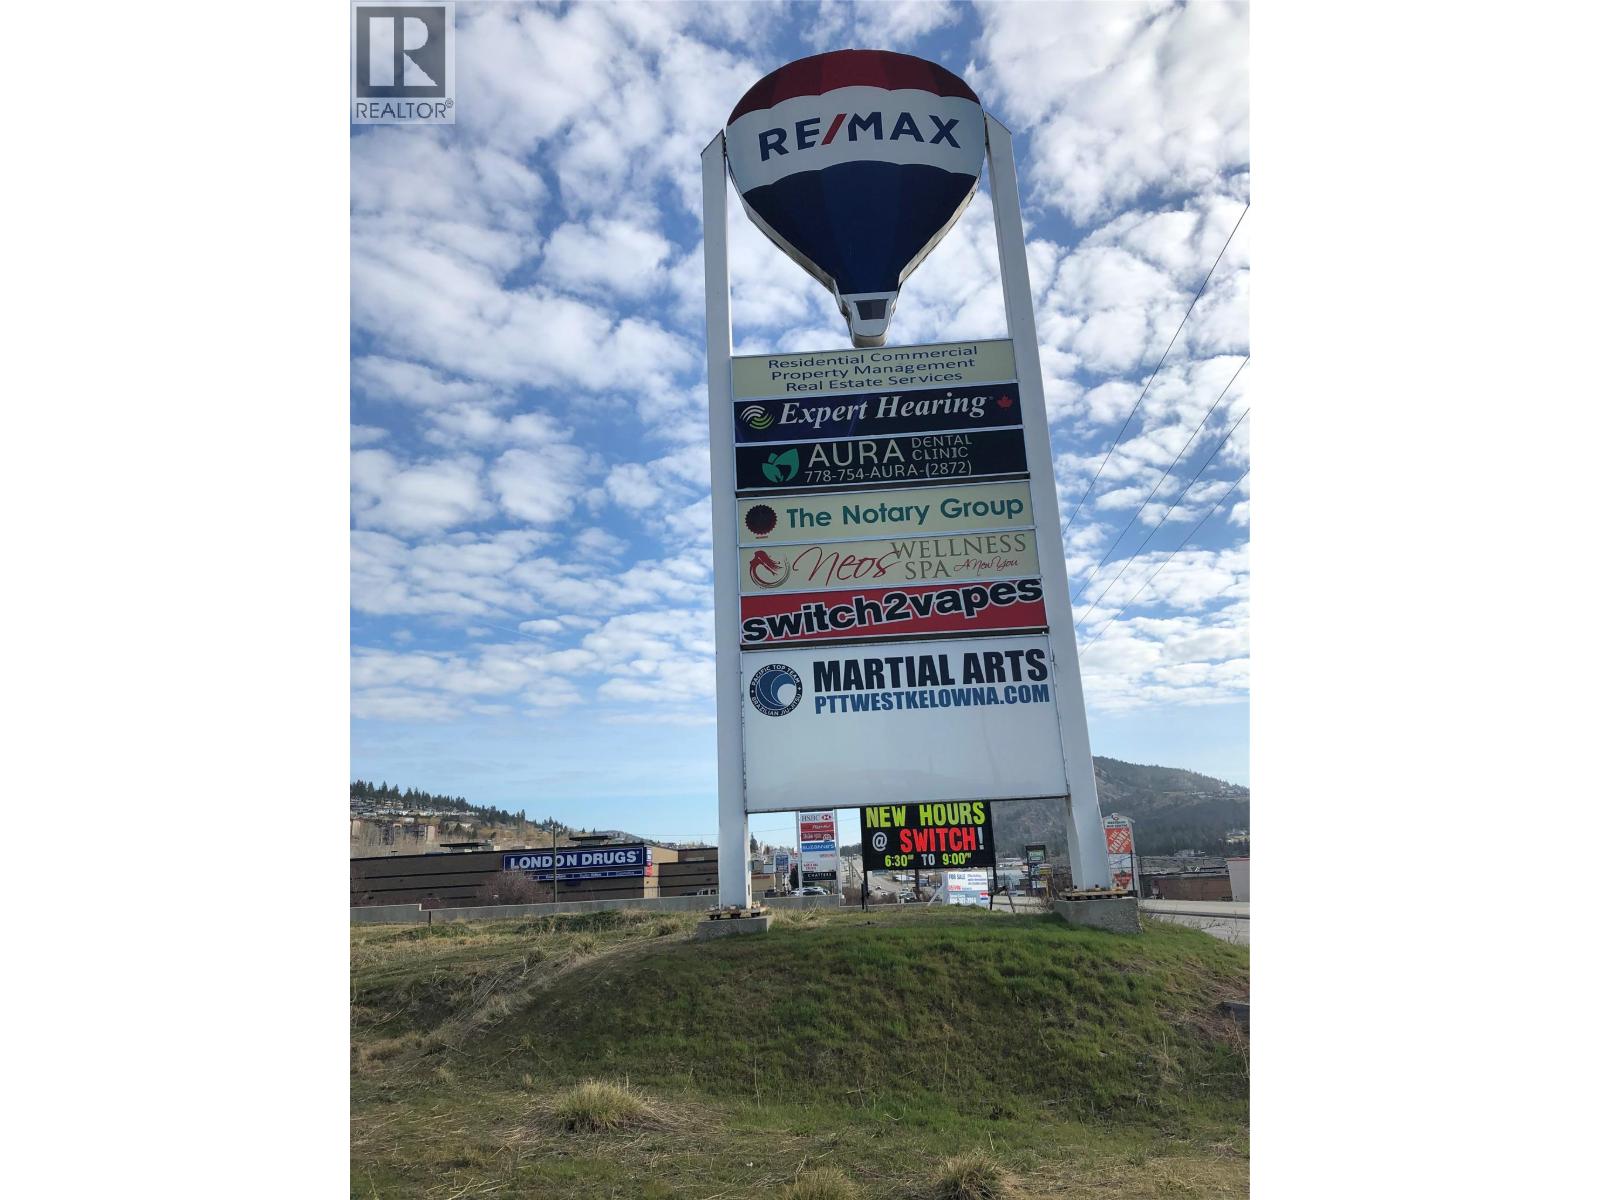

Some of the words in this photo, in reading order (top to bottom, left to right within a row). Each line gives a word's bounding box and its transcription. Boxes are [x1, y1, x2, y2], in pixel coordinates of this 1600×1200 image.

[758, 111, 961, 162] RE/MAX
[768, 355, 865, 370] Residential
[870, 345, 978, 362] Commercial
[771, 369, 849, 381] Property
[854, 357, 976, 375] Management
[786, 380, 823, 392] Real
[829, 377, 883, 389] Estate
[888, 372, 963, 386] Services
[777, 399, 869, 429] Expert
[874, 392, 988, 419] Hearing
[808, 439, 905, 468] AURA
[911, 434, 973, 449] DENTAL
[911, 446, 969, 461] CLINIC
[804, 459, 973, 483] 778-754-AURA-(2872)
[786, 507, 832, 529] The
[843, 502, 930, 526] Notary
[940, 497, 1024, 519] Group
[890, 533, 1027, 560] WELLNESS
[905, 559, 952, 580] SPA
[741, 579, 1044, 642] switch2vapes
[752, 665, 771, 686] PACIFIC
[787, 668, 801, 684] TEAM
[813, 654, 955, 692] MARTIAL
[962, 648, 1048, 684] ARTS
[751, 696, 779, 716] BRAZILIAN
[815, 684, 1050, 714] PTTWESTKELOWNA.COM
[865, 805, 906, 828] NEW
[919, 801, 986, 826] HOURS
[872, 831, 888, 852] @
[899, 827, 985, 853] SWITCH!
[510, 854, 577, 870] LONDON
[581, 850, 637, 866] DRUGS
[921, 853, 936, 866] TO
